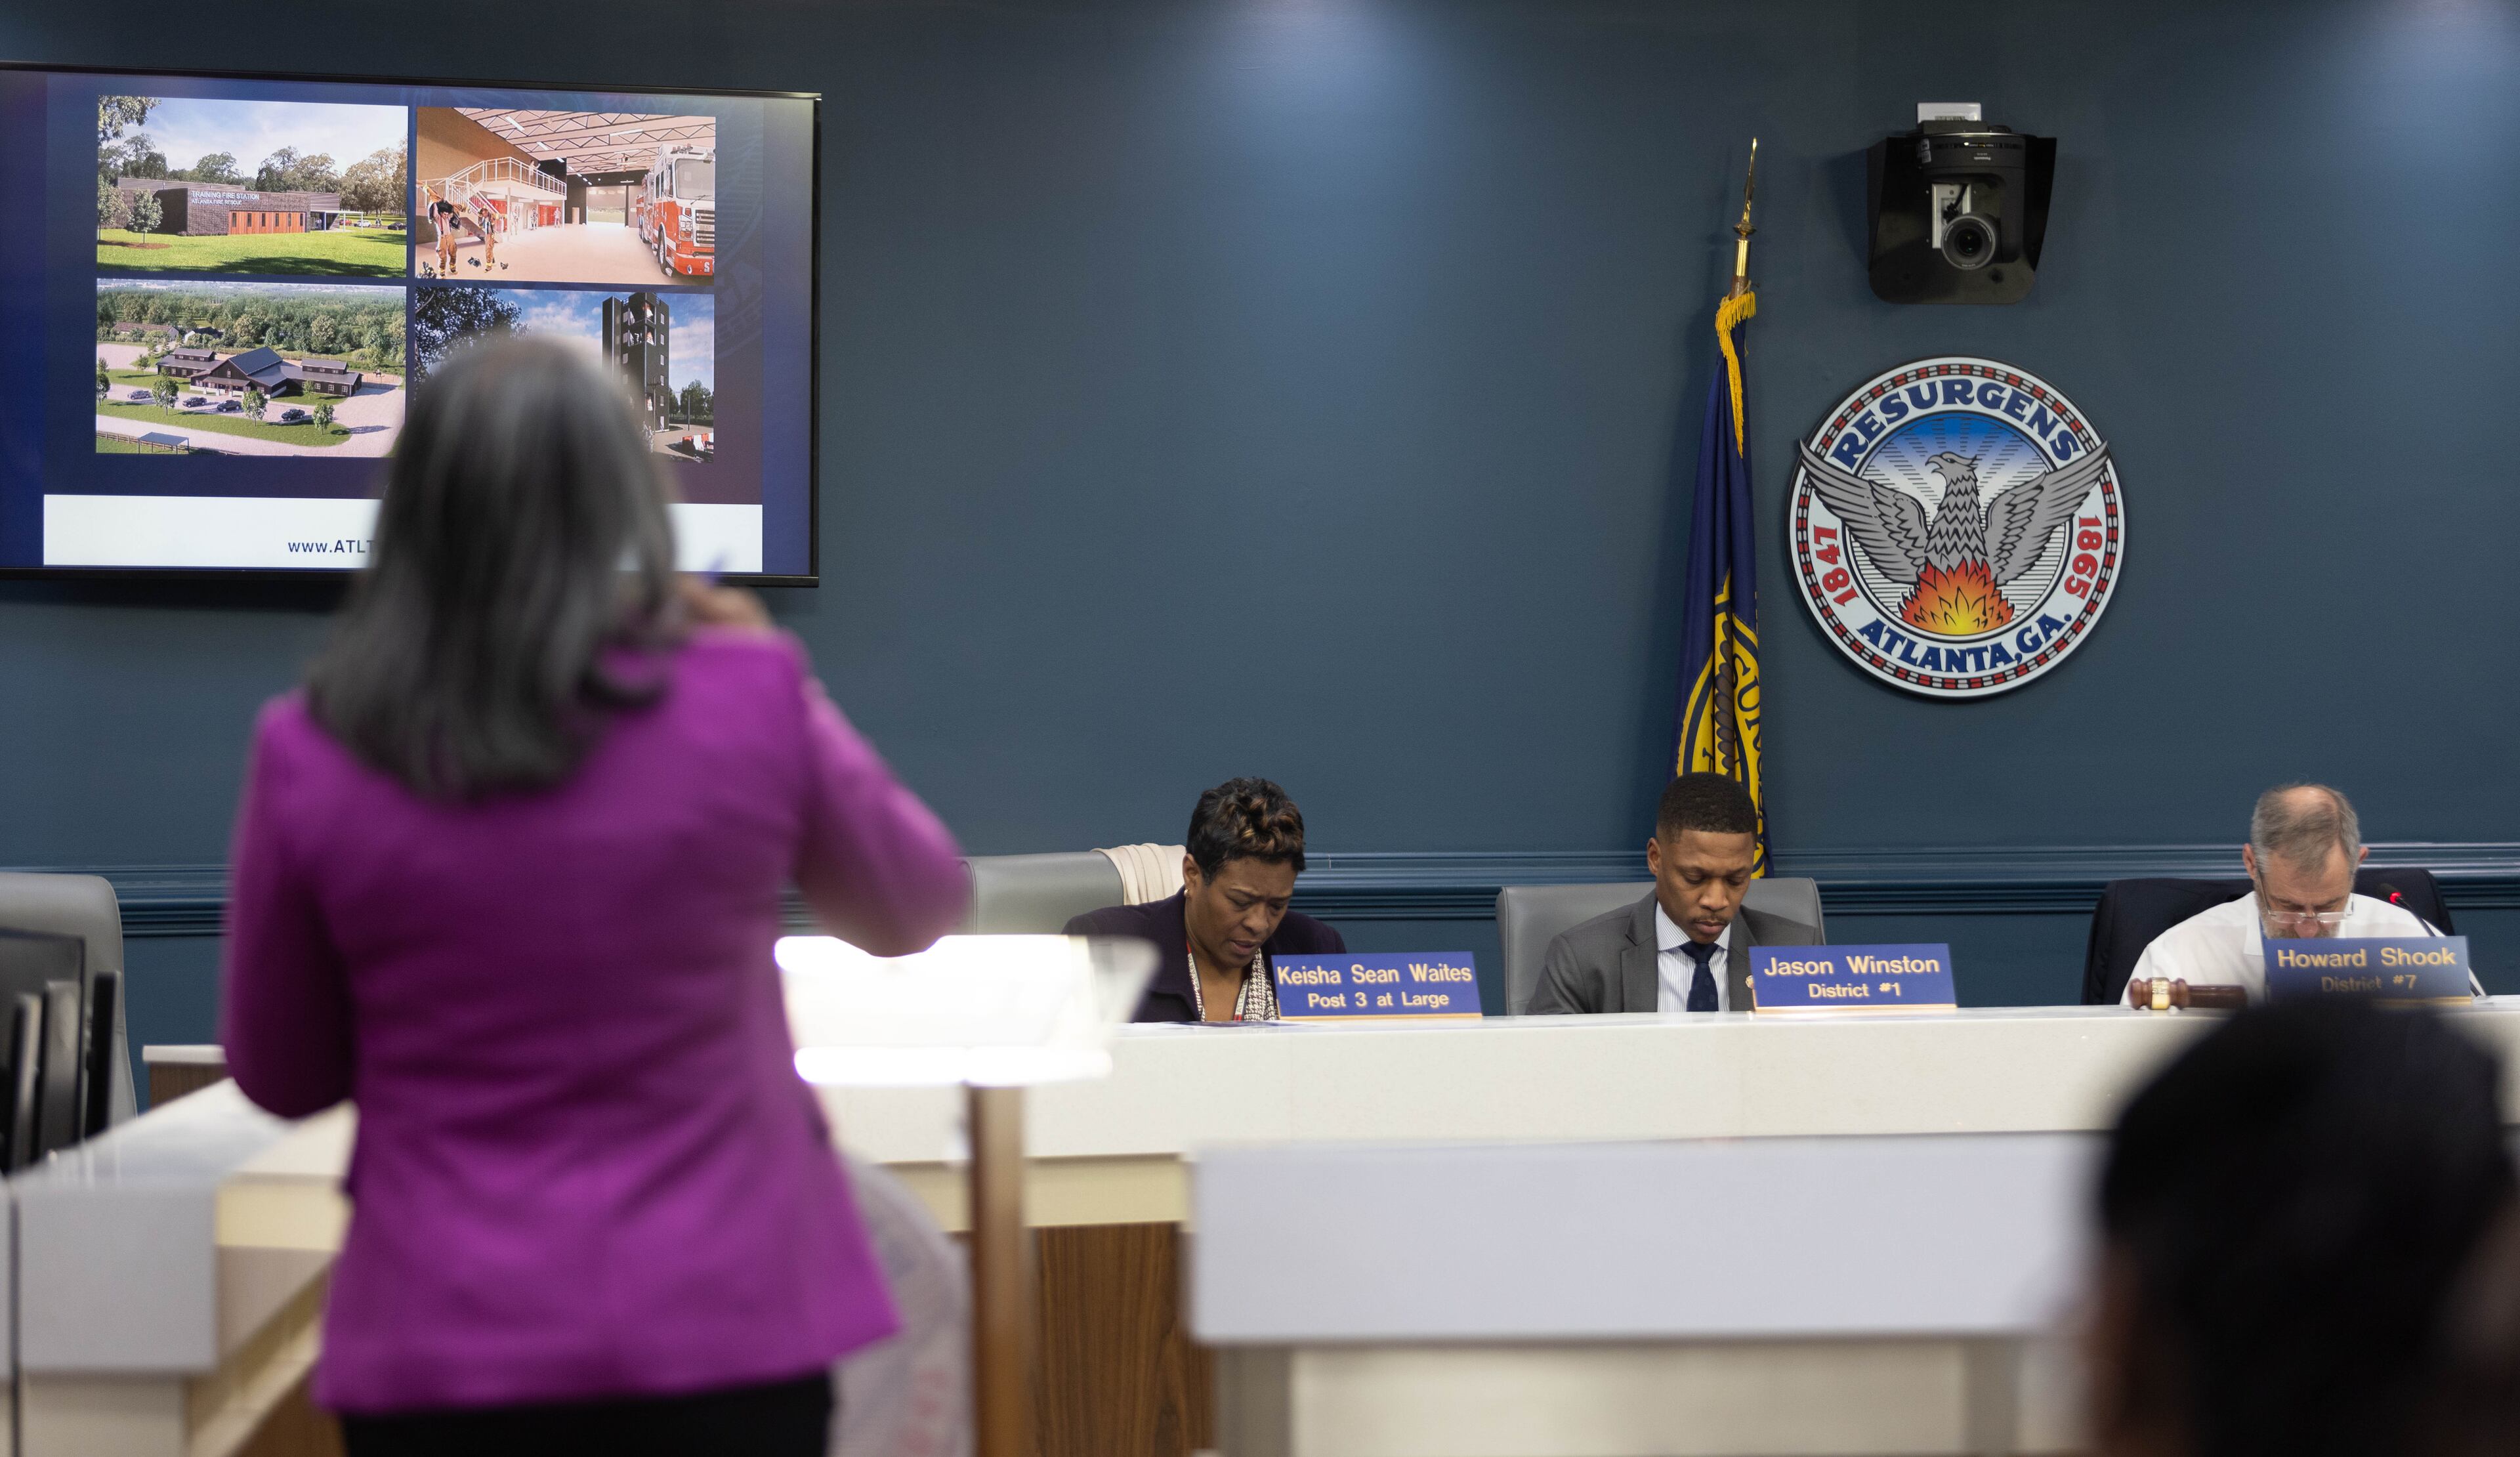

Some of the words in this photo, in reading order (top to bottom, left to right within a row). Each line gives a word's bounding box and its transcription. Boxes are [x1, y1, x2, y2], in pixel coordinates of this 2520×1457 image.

[1830, 379, 2081, 469] RESURGENS
[1813, 525, 1858, 607] 1847
[2064, 515, 2103, 600] 1865
[1764, 957, 1834, 976] Jason
[1846, 955, 1940, 974] Winston
[2277, 948, 2368, 968] Howard
[2380, 946, 2457, 966] Shook
[1277, 965, 1341, 984] Keisha
[1351, 963, 1399, 983] Sean
[1408, 963, 1473, 982] Waites
[2321, 975, 2382, 992] District
[2393, 974, 2417, 990] #7
[1308, 992, 1347, 1008] Post
[1355, 992, 1367, 1007] 3
[1377, 992, 1393, 1007] at
[1402, 991, 1450, 1009] Large
[1809, 983, 1869, 998] District
[1879, 982, 1902, 996] #1
